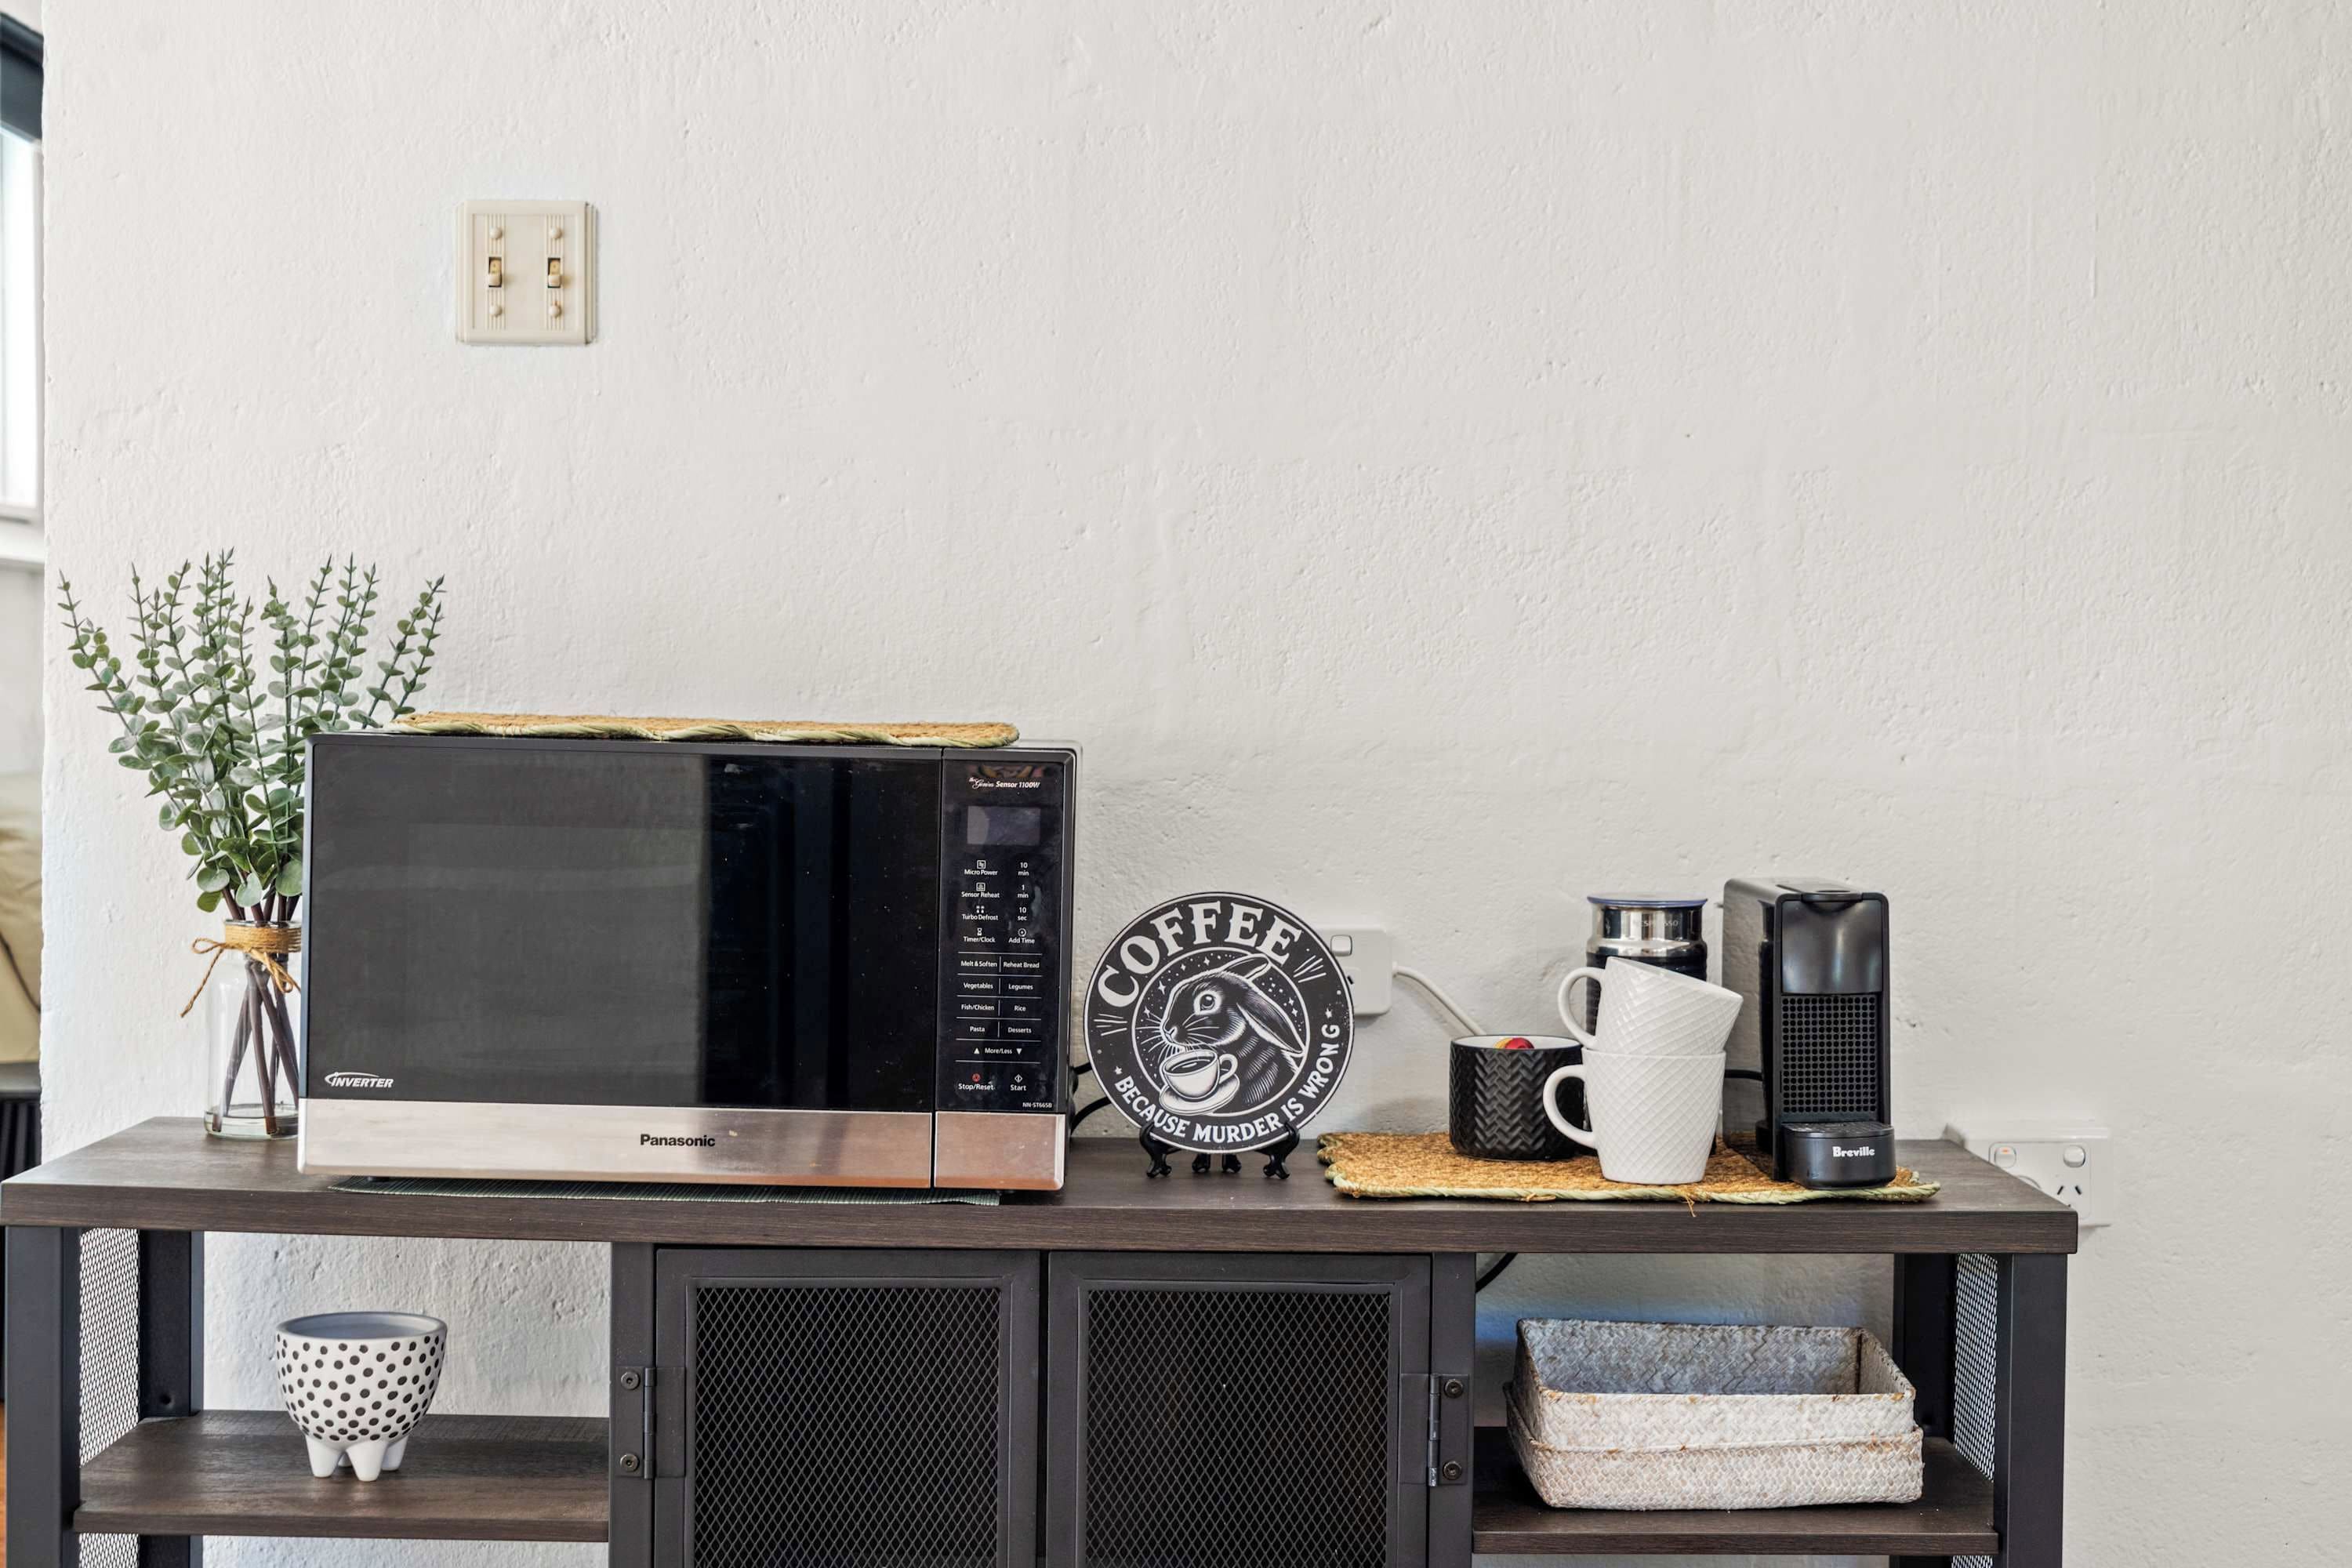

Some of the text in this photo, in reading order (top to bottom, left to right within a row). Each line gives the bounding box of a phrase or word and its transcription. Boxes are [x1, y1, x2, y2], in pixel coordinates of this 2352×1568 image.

[1098, 901, 1301, 1007] COFFEE
[331, 1072, 394, 1088] INVERTER
[1115, 1024, 1341, 1143] BECAUSE MURDER IS WRONG
[640, 1134, 716, 1147] Panasonic
[1832, 1146, 1875, 1157] Breville
